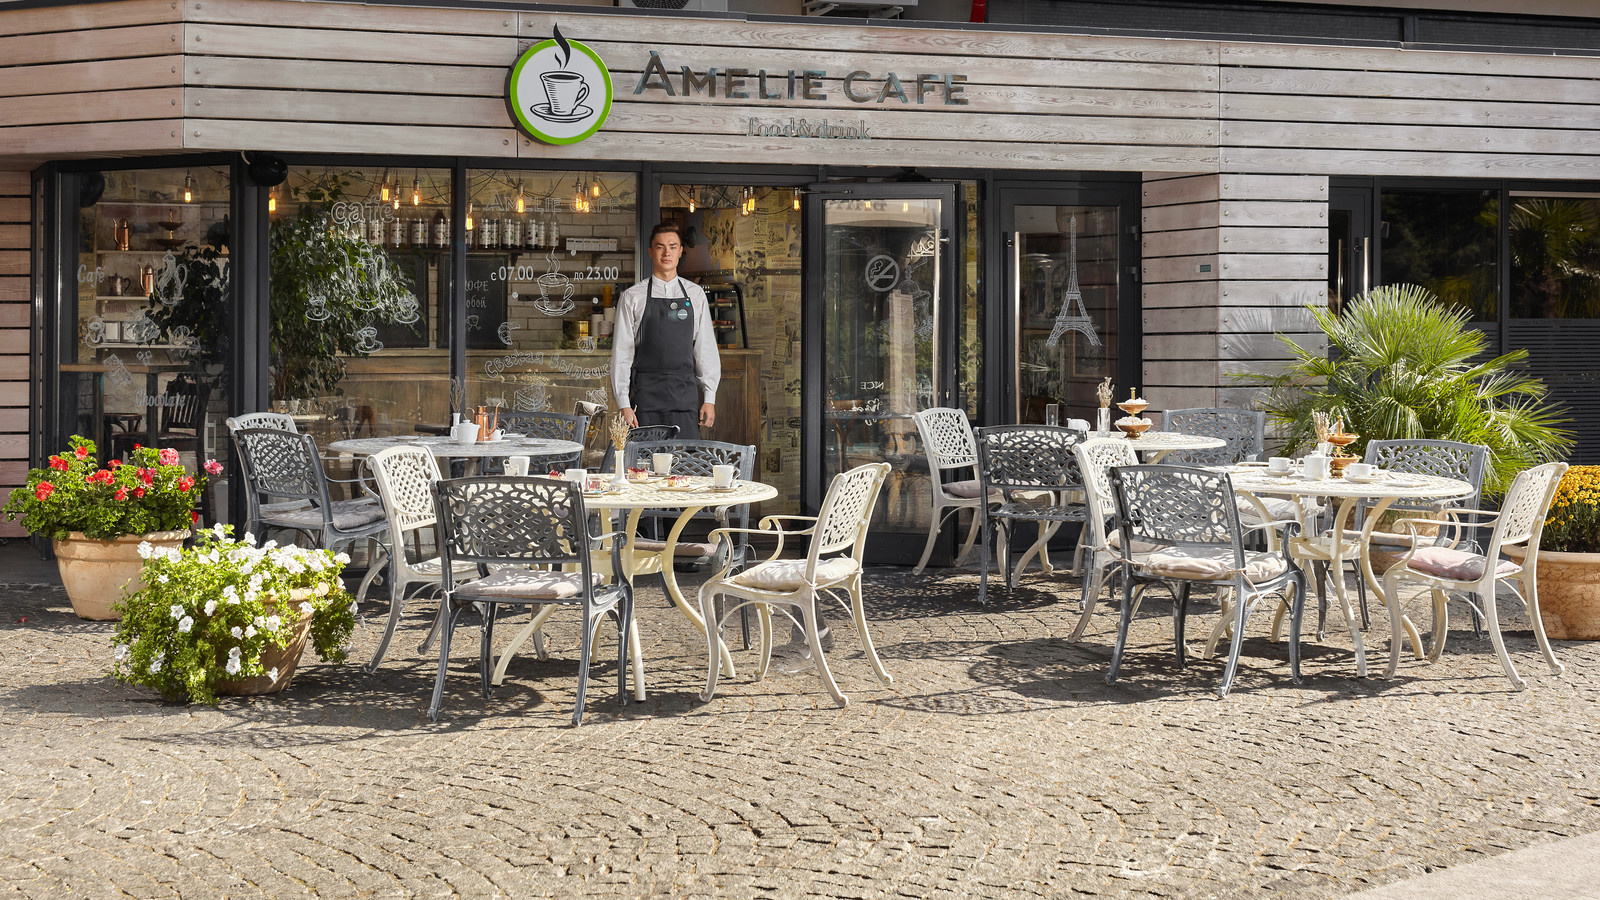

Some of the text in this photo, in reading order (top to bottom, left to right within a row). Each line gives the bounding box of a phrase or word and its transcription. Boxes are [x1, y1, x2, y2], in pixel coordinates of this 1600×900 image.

[633, 49, 969, 105] AMELIE CAFE
[498, 265, 534, 281] 07.00
[586, 265, 619, 281] 23.00
[134, 389, 186, 407] Chocolate
